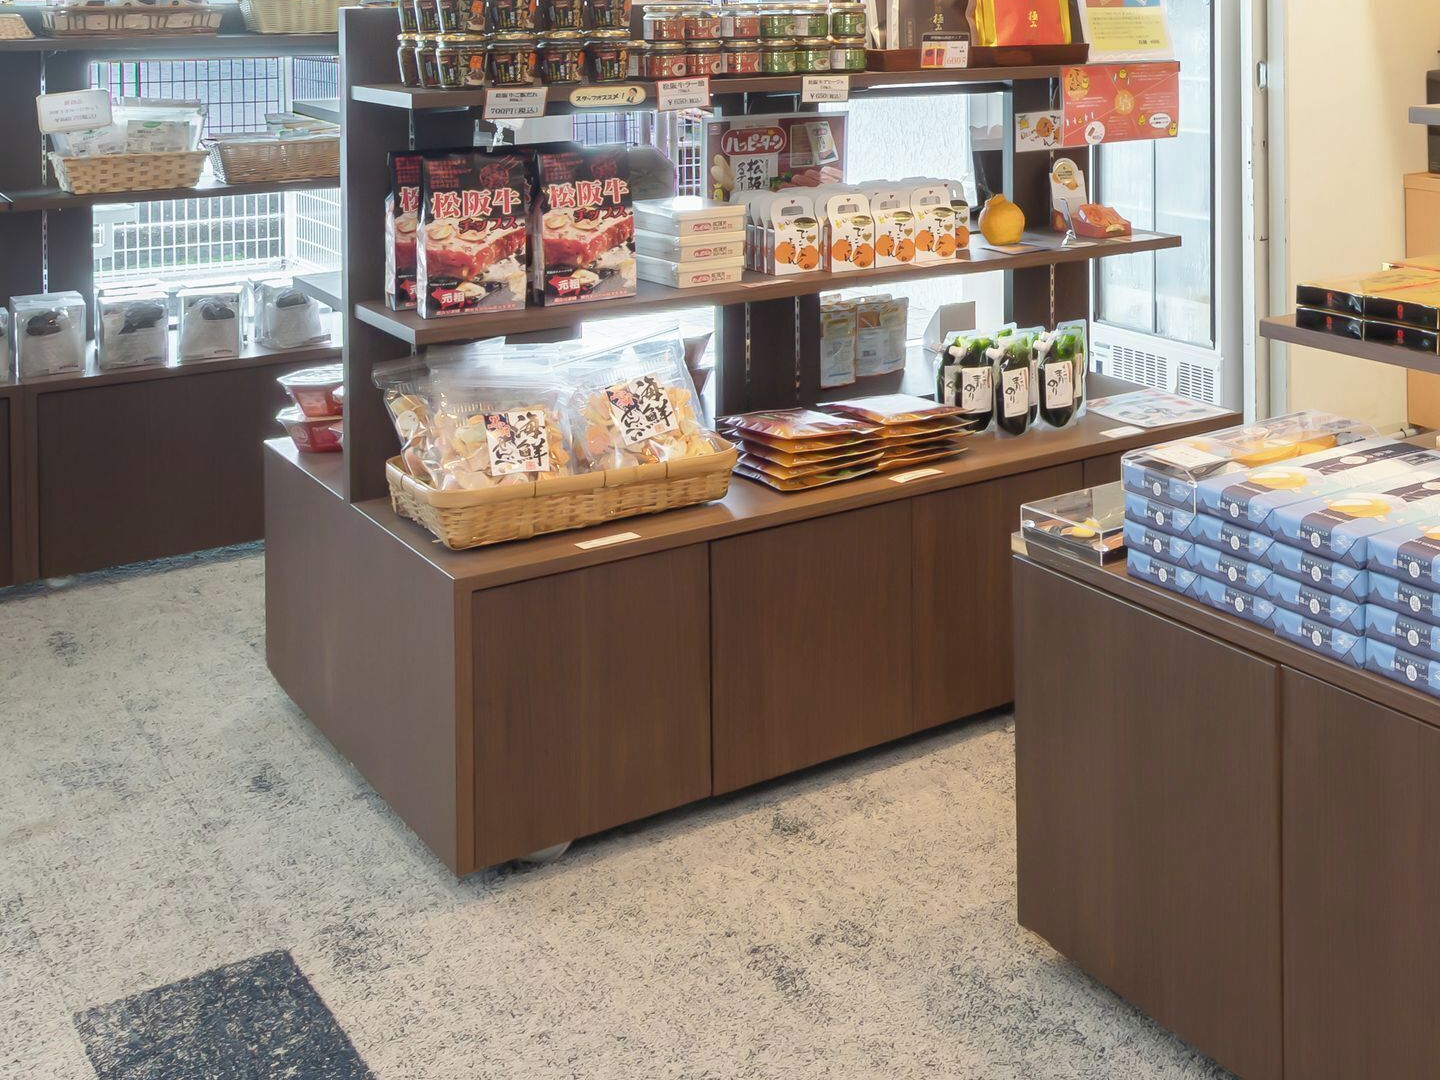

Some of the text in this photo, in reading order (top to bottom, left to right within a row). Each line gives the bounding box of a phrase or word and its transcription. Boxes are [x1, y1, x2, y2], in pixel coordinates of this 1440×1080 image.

[726, 130, 783, 153] ハッピーターン
[431, 187, 522, 220] 松阪牛
[549, 177, 631, 209] 松阪牛
[458, 216, 519, 234] チップス
[574, 205, 628, 222] チップス
[557, 277, 581, 291] 元祖
[439, 289, 466, 305] 元祖
[633, 375, 673, 427] 海鮮
[516, 411, 547, 467] 海鮮
